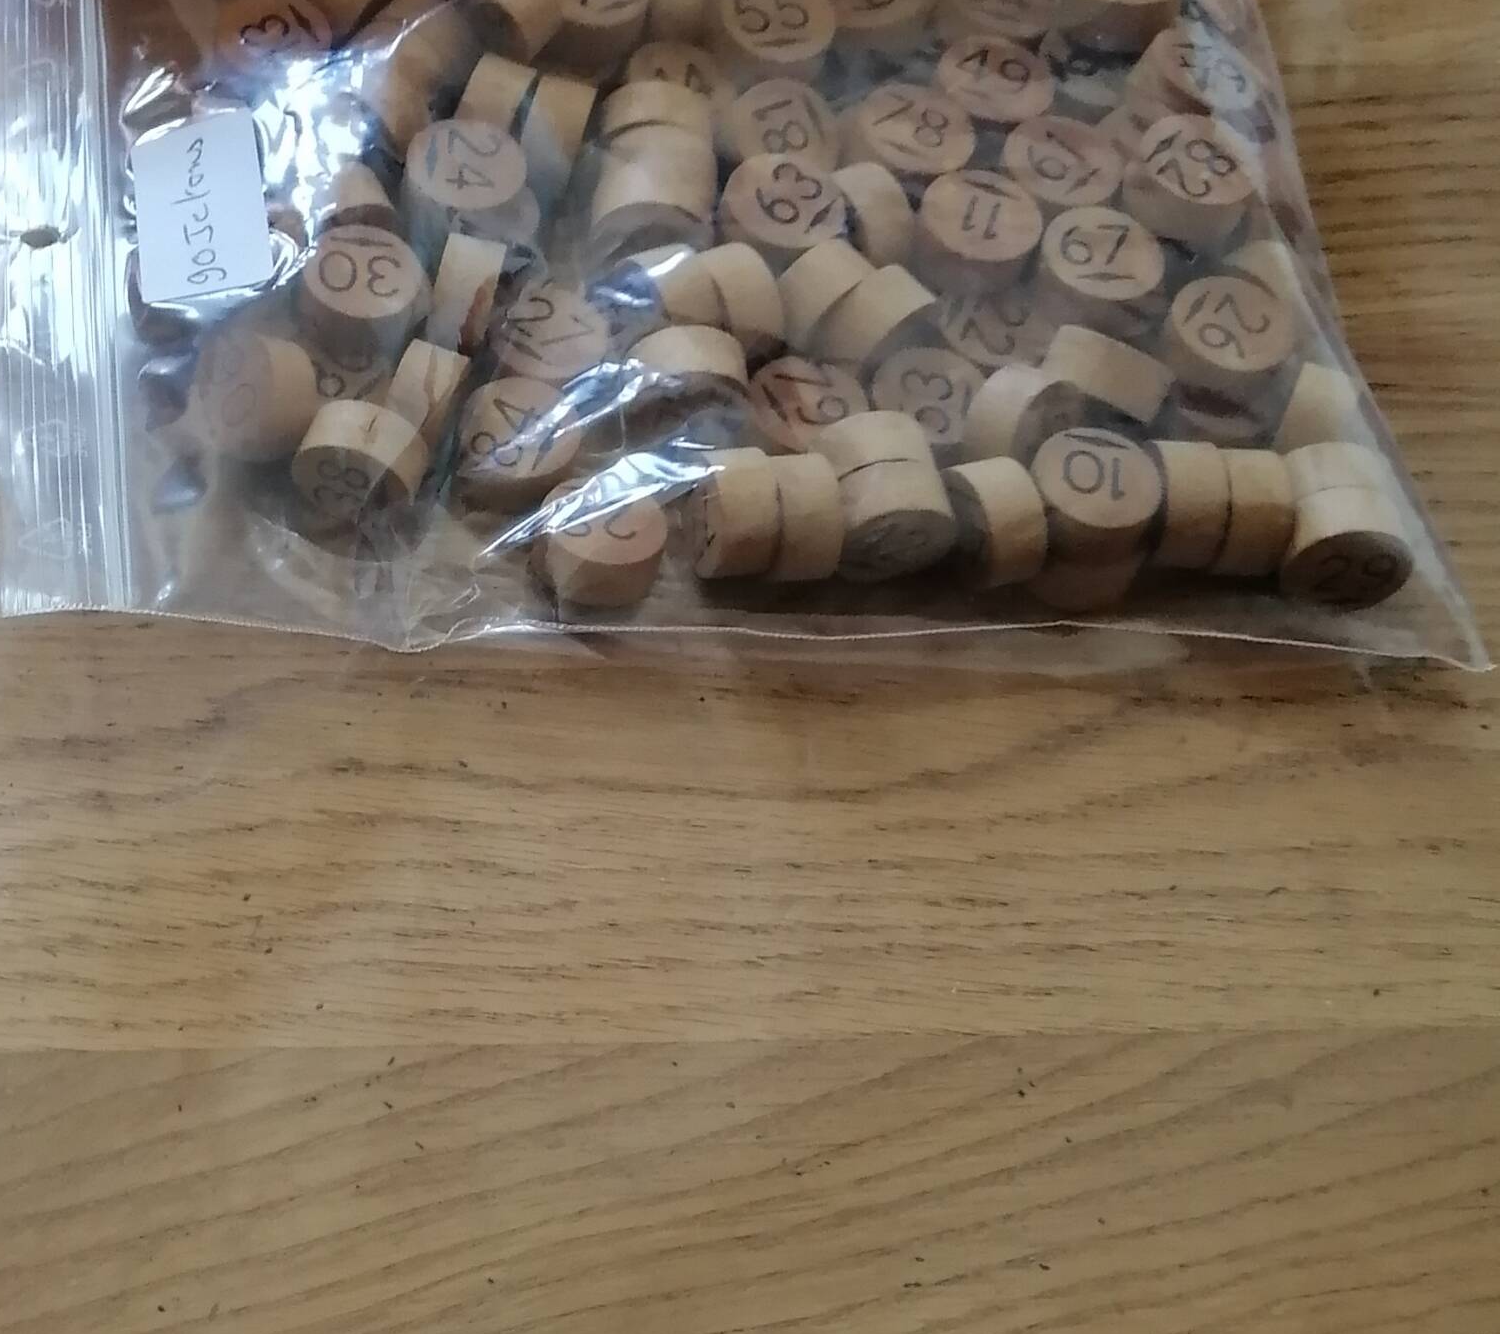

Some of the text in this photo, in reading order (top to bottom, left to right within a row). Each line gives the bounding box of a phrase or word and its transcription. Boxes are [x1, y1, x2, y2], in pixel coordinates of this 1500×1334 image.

[957, 49, 1030, 94] 49
[872, 91, 949, 148] 78
[447, 127, 502, 190] 24
[1156, 139, 1238, 197] 82
[755, 162, 822, 224] 63
[961, 196, 1001, 241] 11
[1060, 224, 1130, 266] 67
[319, 251, 400, 298] 30
[1198, 293, 1270, 360] 26
[1063, 450, 1126, 501] 10
